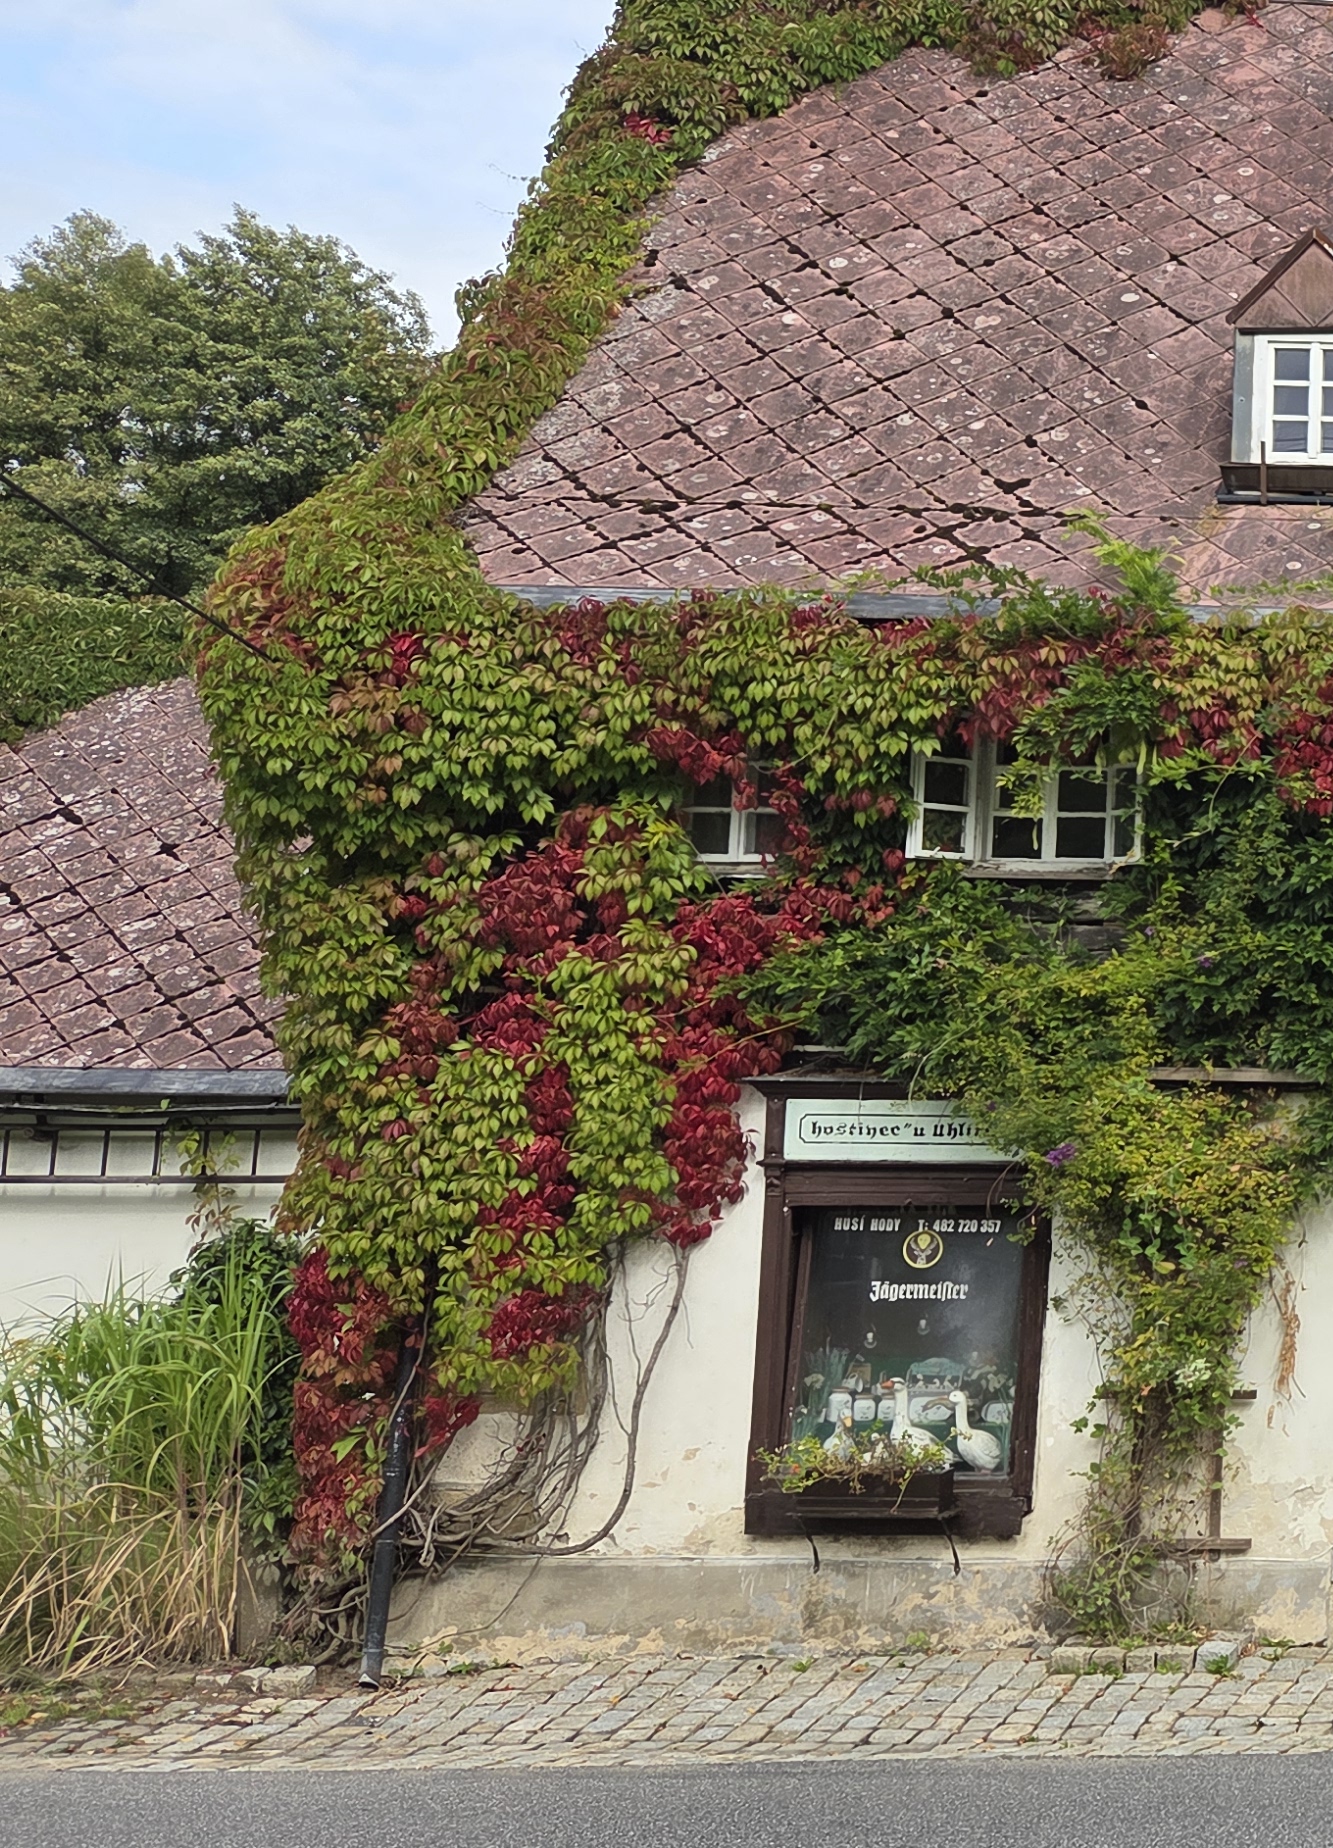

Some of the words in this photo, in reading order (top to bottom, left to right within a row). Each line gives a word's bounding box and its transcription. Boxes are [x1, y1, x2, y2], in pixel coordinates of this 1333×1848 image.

[834, 1214, 866, 1231] HUSÍ
[870, 1218, 901, 1231] HODY
[932, 1219, 955, 1232] 482
[958, 1219, 978, 1232] 720
[980, 1219, 1001, 1232] 357
[869, 1281, 969, 1302] Jägermeister
